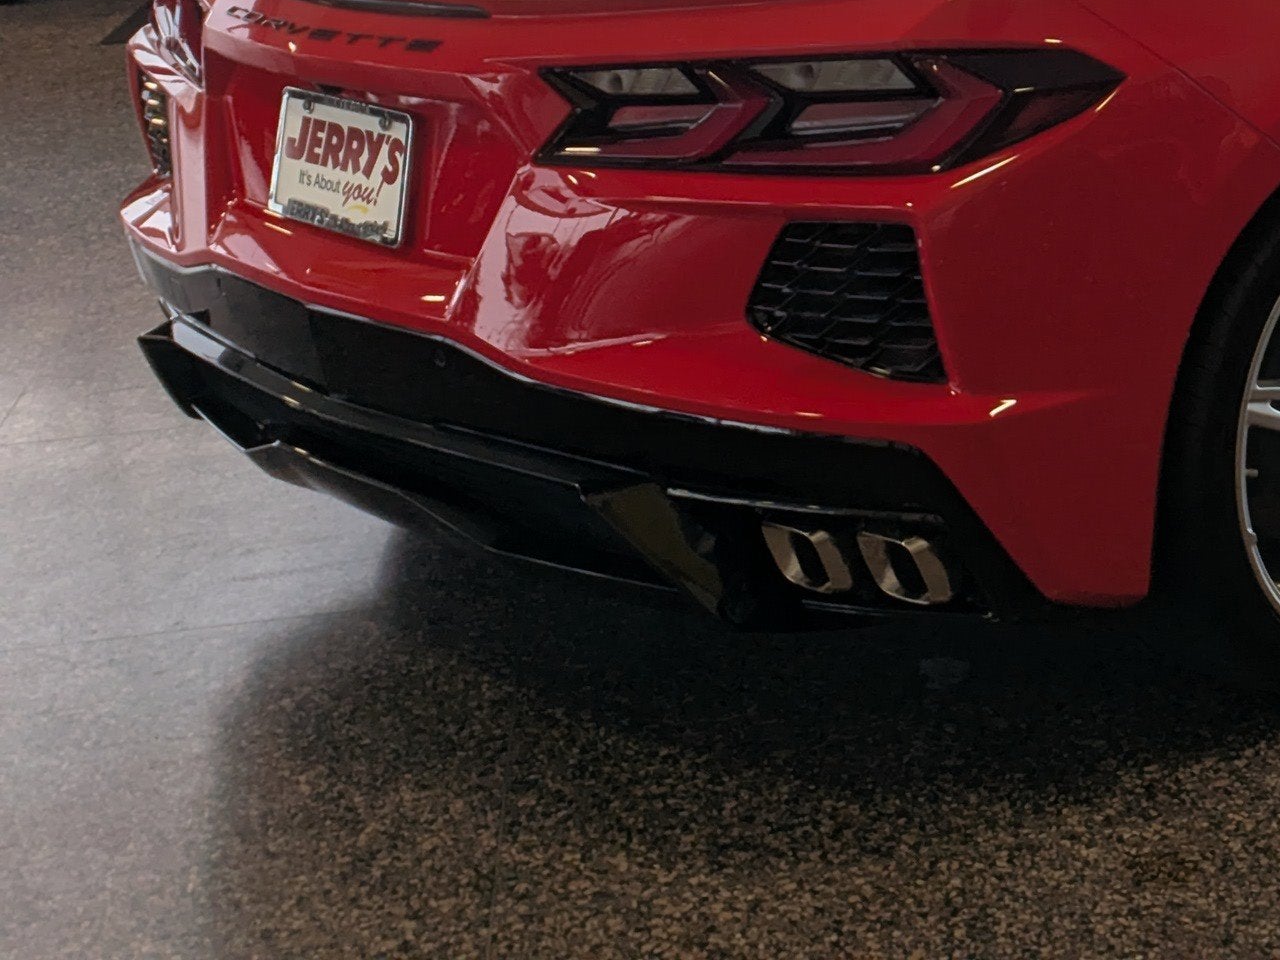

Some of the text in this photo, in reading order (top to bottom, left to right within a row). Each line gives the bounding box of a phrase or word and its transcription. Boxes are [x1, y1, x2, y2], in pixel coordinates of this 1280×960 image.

[227, 6, 445, 53] CORVETTE
[284, 115, 405, 186] JERRY'S
[299, 168, 387, 207] It's About you!
